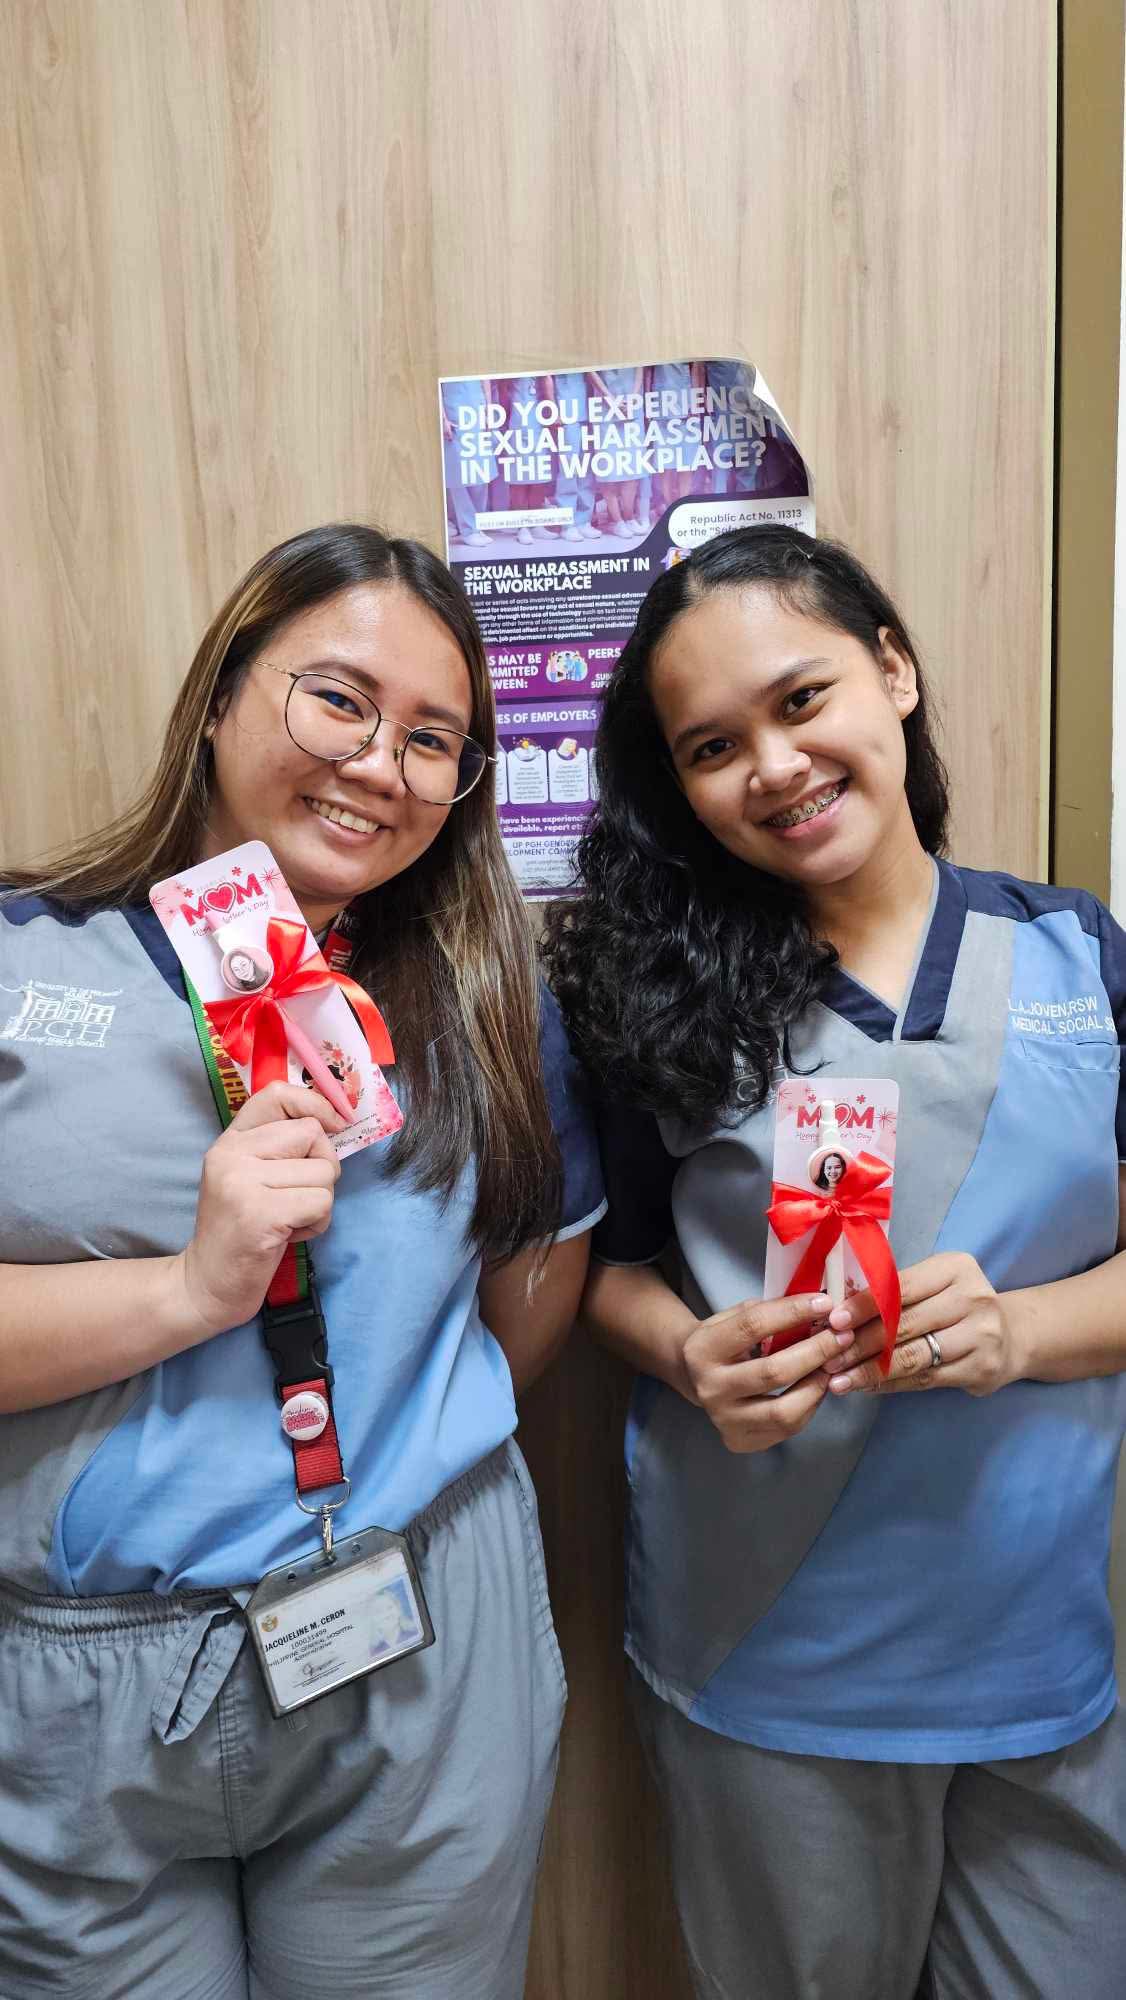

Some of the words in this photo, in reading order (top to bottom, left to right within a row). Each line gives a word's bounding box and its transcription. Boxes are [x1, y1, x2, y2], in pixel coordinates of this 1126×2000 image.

[458, 403, 507, 430] DID
[513, 399, 579, 427] YOU
[460, 427, 572, 457] SEXUAL
[581, 415, 778, 450] HARASSMENT
[461, 459, 490, 484] IN
[498, 456, 552, 482] THE
[559, 441, 766, 480] WORKPLACE?
[691, 513, 736, 525] Republic
[739, 512, 757, 521] Act
[759, 511, 776, 520] No.
[778, 509, 802, 519] 11313
[690, 527, 707, 536] the
[464, 566, 522, 581] SEXUAL
[526, 559, 629, 578] HARASSMENT
[634, 557, 650, 572] IN
[464, 581, 492, 596] THE
[495, 575, 592, 594] WORKPLACE
[602, 592, 621, 600] sexual
[498, 654, 525, 666] MAY
[528, 653, 542, 664] BE
[588, 648, 621, 659] PEERS
[490, 665, 539, 678] MMITTED
[492, 678, 528, 690] WEEN:
[513, 712, 528, 724] OF
[530, 709, 597, 723] EMPLOYERS
[500, 816, 519, 825] have
[521, 815, 540, 824] been
[504, 824, 542, 833] available,
[512, 841, 523, 849] UP
[525, 840, 541, 848] PGH
[20, 1019, 112, 1041] PGH
[1011, 1014, 1056, 1035] MEDICAL
[1058, 1014, 1104, 1034] SOCIAL
[265, 1625, 309, 1653] JACQUELINE
[309, 1621, 320, 1631] M.
[320, 1608, 346, 1626] CERON
